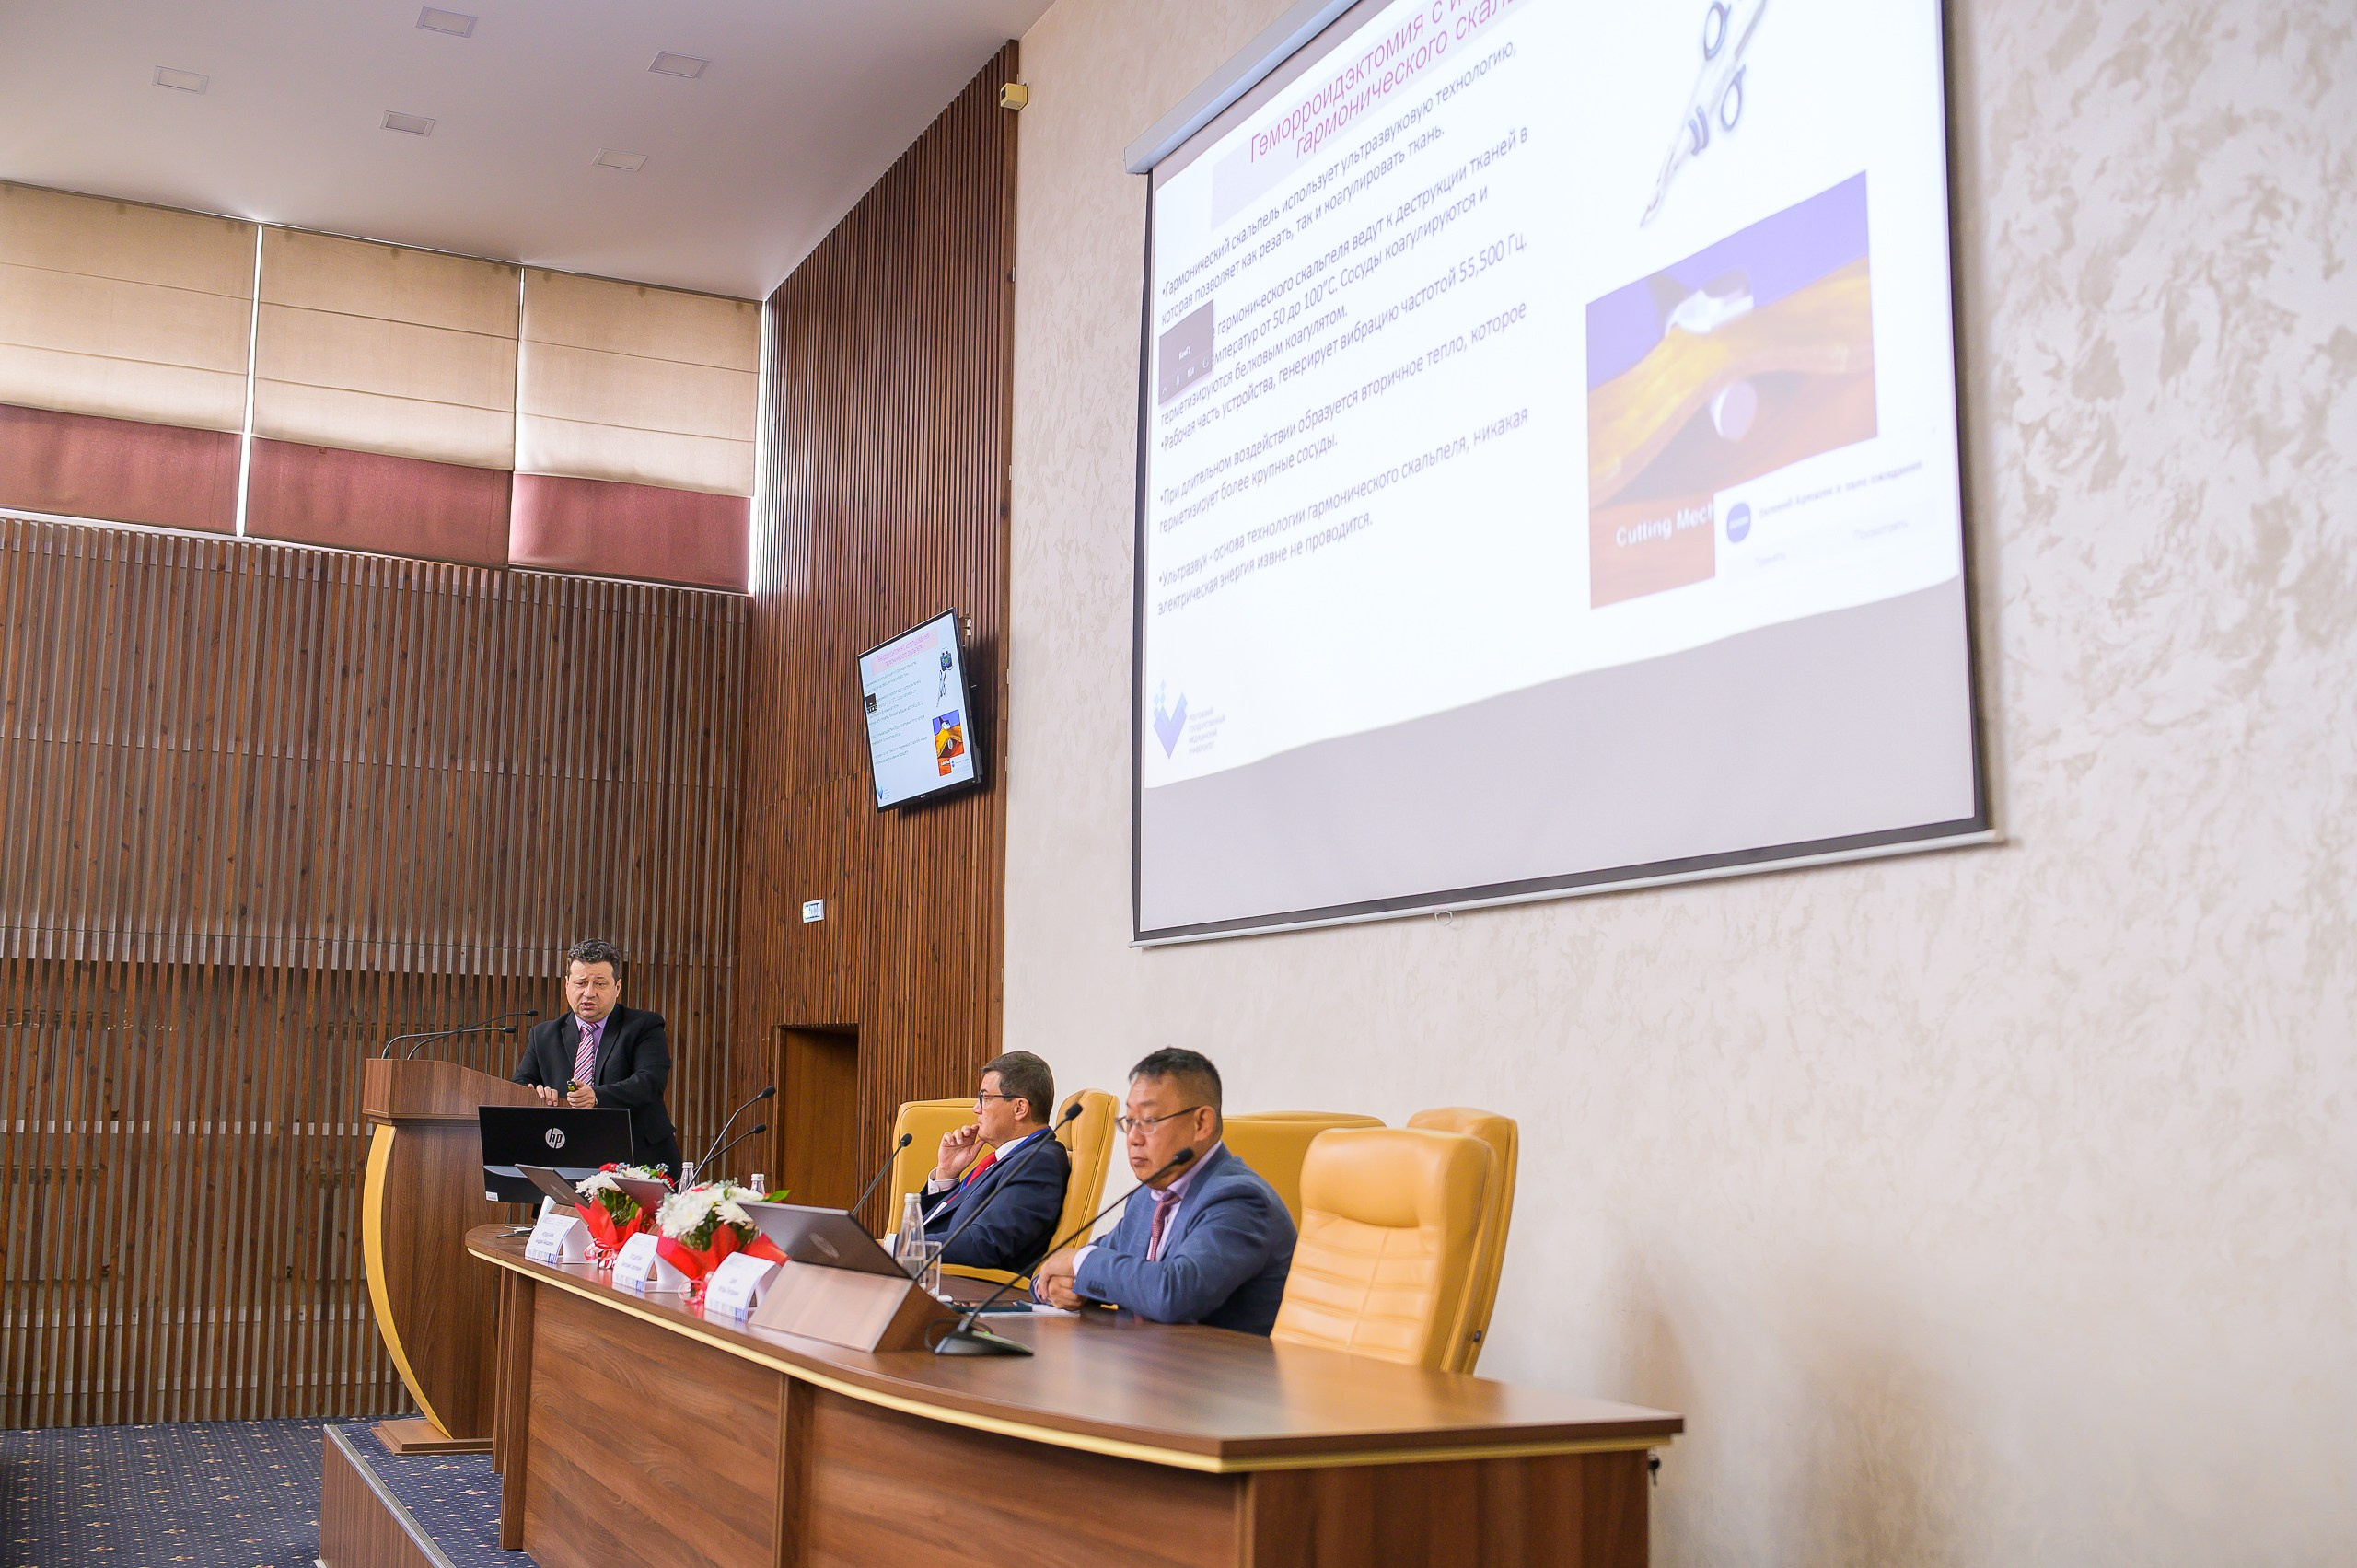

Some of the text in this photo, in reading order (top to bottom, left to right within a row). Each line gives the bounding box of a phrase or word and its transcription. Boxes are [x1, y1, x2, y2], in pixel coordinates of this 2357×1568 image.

[1250, 12, 1424, 163] Геморроидэктомия
[1431, 0, 1443, 25] с
[1291, 29, 1448, 159] гармонического
[1161, 125, 1445, 327] которая позволяет как резать, так и коагулировать ткань.
[1165, 41, 1516, 298] Гармонический скальпель использует ультразвуковую технологию,
[1217, 126, 1528, 336] гармонического скальпеля ведут к деструкции тканей в
[1260, 318, 1272, 338] от
[1272, 306, 1286, 330] 50
[1286, 301, 1302, 325] до
[1340, 250, 1382, 287] Сосуды
[1385, 192, 1476, 261] коагулируются
[1479, 185, 1488, 203] и
[1160, 304, 1348, 427] герметизируются белковым коагулятом.
[1163, 302, 1527, 506] При длительном воздействии образуется вторичное тепло, которое
[1164, 232, 1527, 452] Рабочая часть устройства, генерирует вибрацию частотой 55,500 Гц.
[1159, 433, 1338, 534] герметизирует более крупные сосуды.
[1162, 553, 1207, 587] Ультразвук
[1213, 534, 1246, 563] основа
[1246, 508, 1306, 545] технологии
[1307, 467, 1399, 520] гармонического
[1400, 436, 1469, 480] скальпеля,
[1473, 407, 1528, 447] никакая
[1616, 517, 1672, 548] Cutting
[1157, 511, 1373, 617] электрическая энергия извне не проводится.
[548, 1127, 563, 1149] hp
